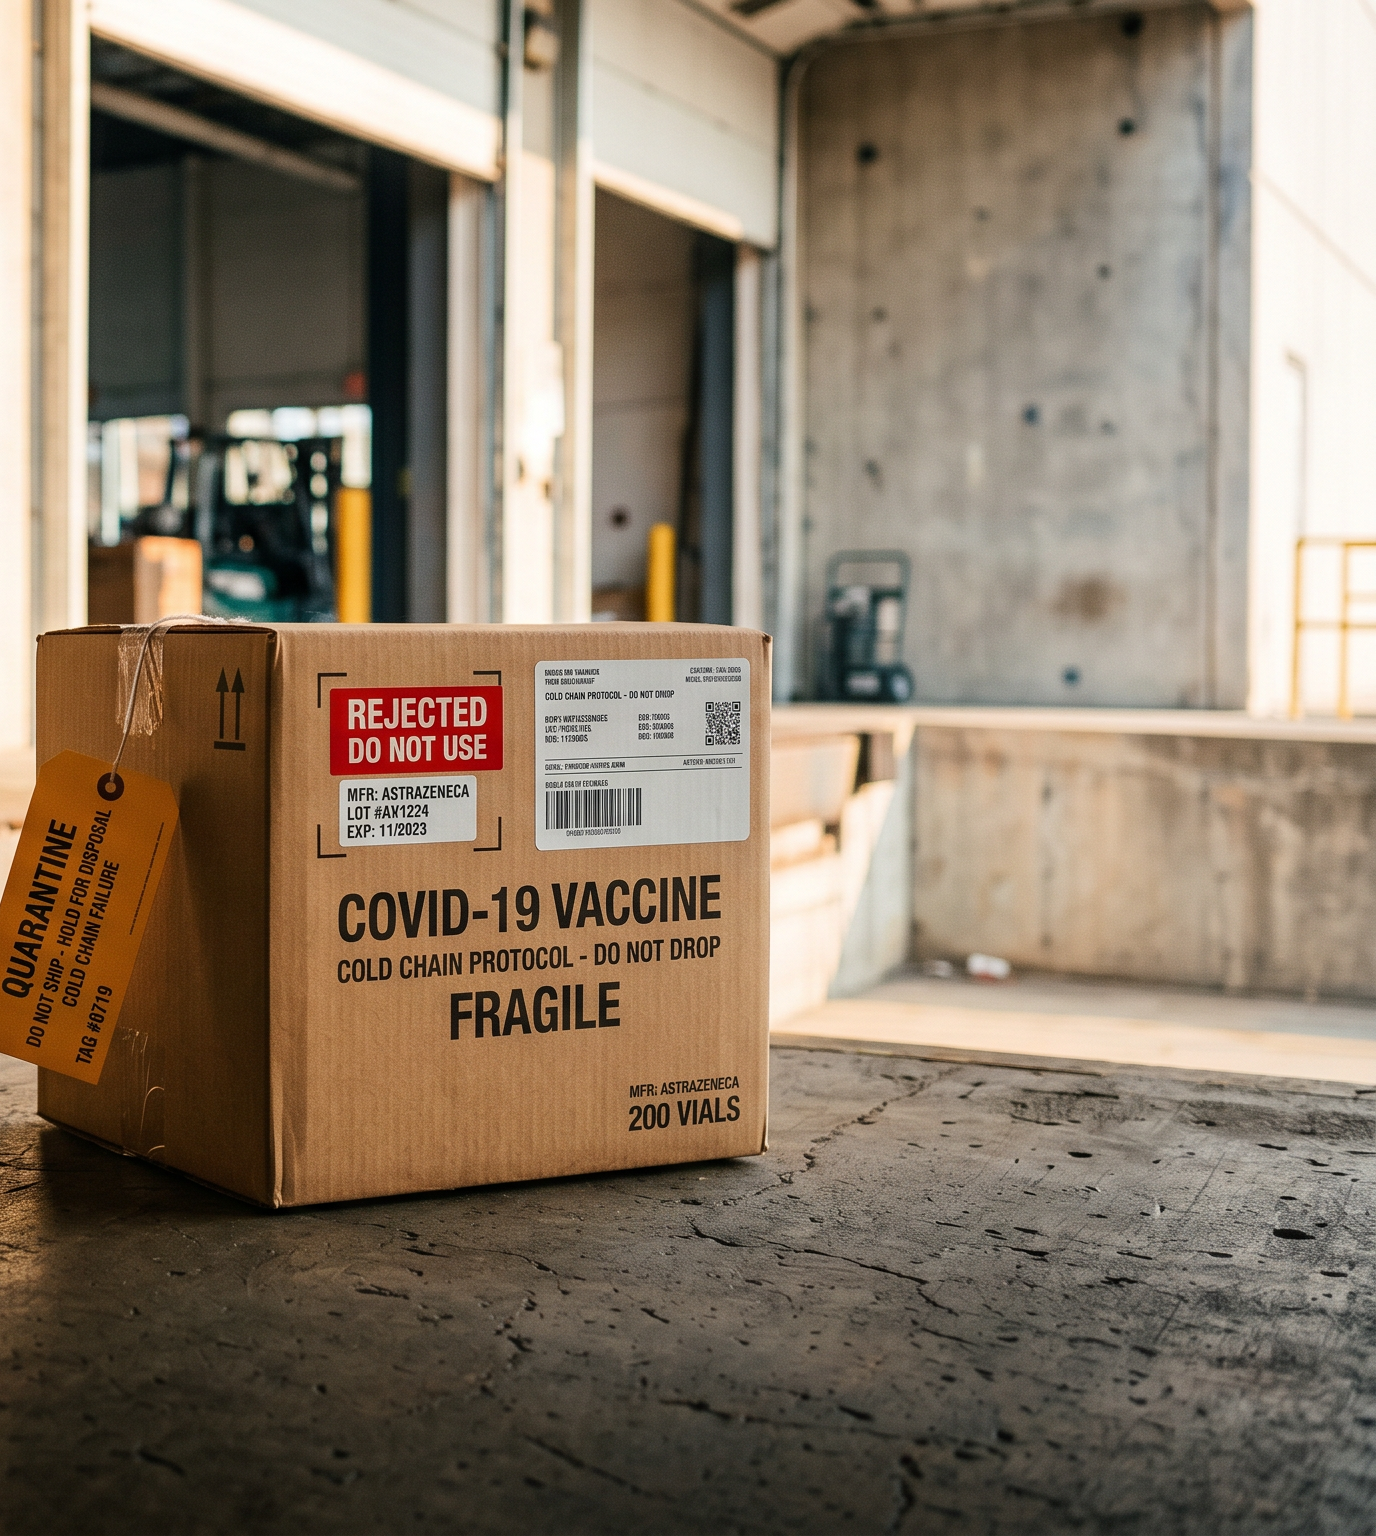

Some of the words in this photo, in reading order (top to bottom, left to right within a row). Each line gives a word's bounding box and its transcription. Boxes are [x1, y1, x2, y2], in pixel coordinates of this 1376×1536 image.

[545, 692, 563, 701] COLD
[565, 691, 586, 700] CHAIN
[588, 691, 622, 700] PROTOCOL
[640, 691, 653, 699] NOT
[348, 696, 487, 730] REJECTED
[348, 737, 381, 764] DO
[390, 736, 436, 762] NOT
[443, 734, 487, 761] USE
[347, 788, 377, 802] MFR:
[382, 784, 469, 800] ASTRAZENECA
[347, 806, 370, 820] LOT
[79, 809, 112, 876] DISPOSAL
[347, 825, 375, 839] EXP:
[380, 822, 427, 837] 11/2023
[2, 819, 77, 999] QUARANTINE
[69, 878, 89, 907] FOR
[338, 885, 540, 943] COVID-19
[551, 874, 721, 929] VACCINE
[56, 907, 81, 948] HOLD
[62, 972, 86, 1007] COLD
[76, 922, 98, 966] CHAIN
[88, 860, 120, 920] FAILURE
[43, 958, 65, 992] SHIP
[337, 957, 392, 983] COLD
[399, 952, 462, 979] CHAIN
[470, 946, 574, 975] PROTOCOL
[594, 942, 620, 966] DO
[626, 939, 665, 963] NOT
[670, 936, 721, 960] DROP
[32, 992, 55, 1025] NOT
[450, 981, 621, 1040] FRAGILE
[26, 1025, 45, 1048] DO
[76, 1035, 97, 1065] TAG
[660, 1076, 739, 1096] ASTRAZENECA
[628, 1103, 670, 1131] 200
[677, 1095, 740, 1126] VIALS
